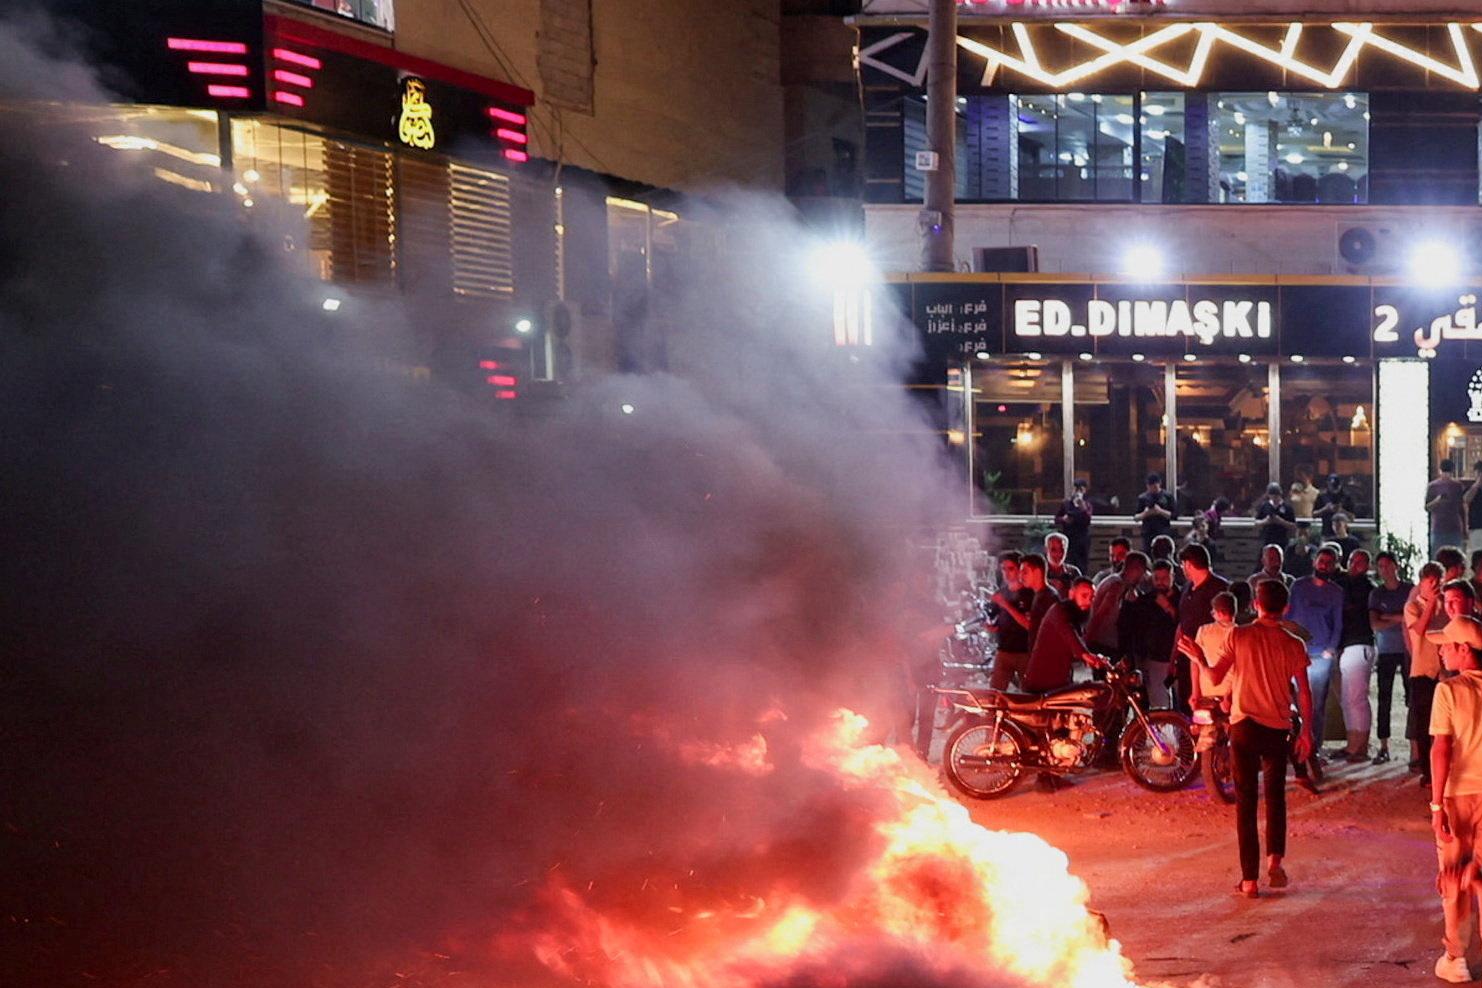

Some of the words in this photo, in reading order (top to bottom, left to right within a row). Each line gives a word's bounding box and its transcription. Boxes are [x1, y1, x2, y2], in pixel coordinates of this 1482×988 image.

[926, 303, 953, 319] الباب
[964, 300, 987, 315] فرع
[964, 319, 987, 334] فرع
[1373, 304, 1400, 343] 2
